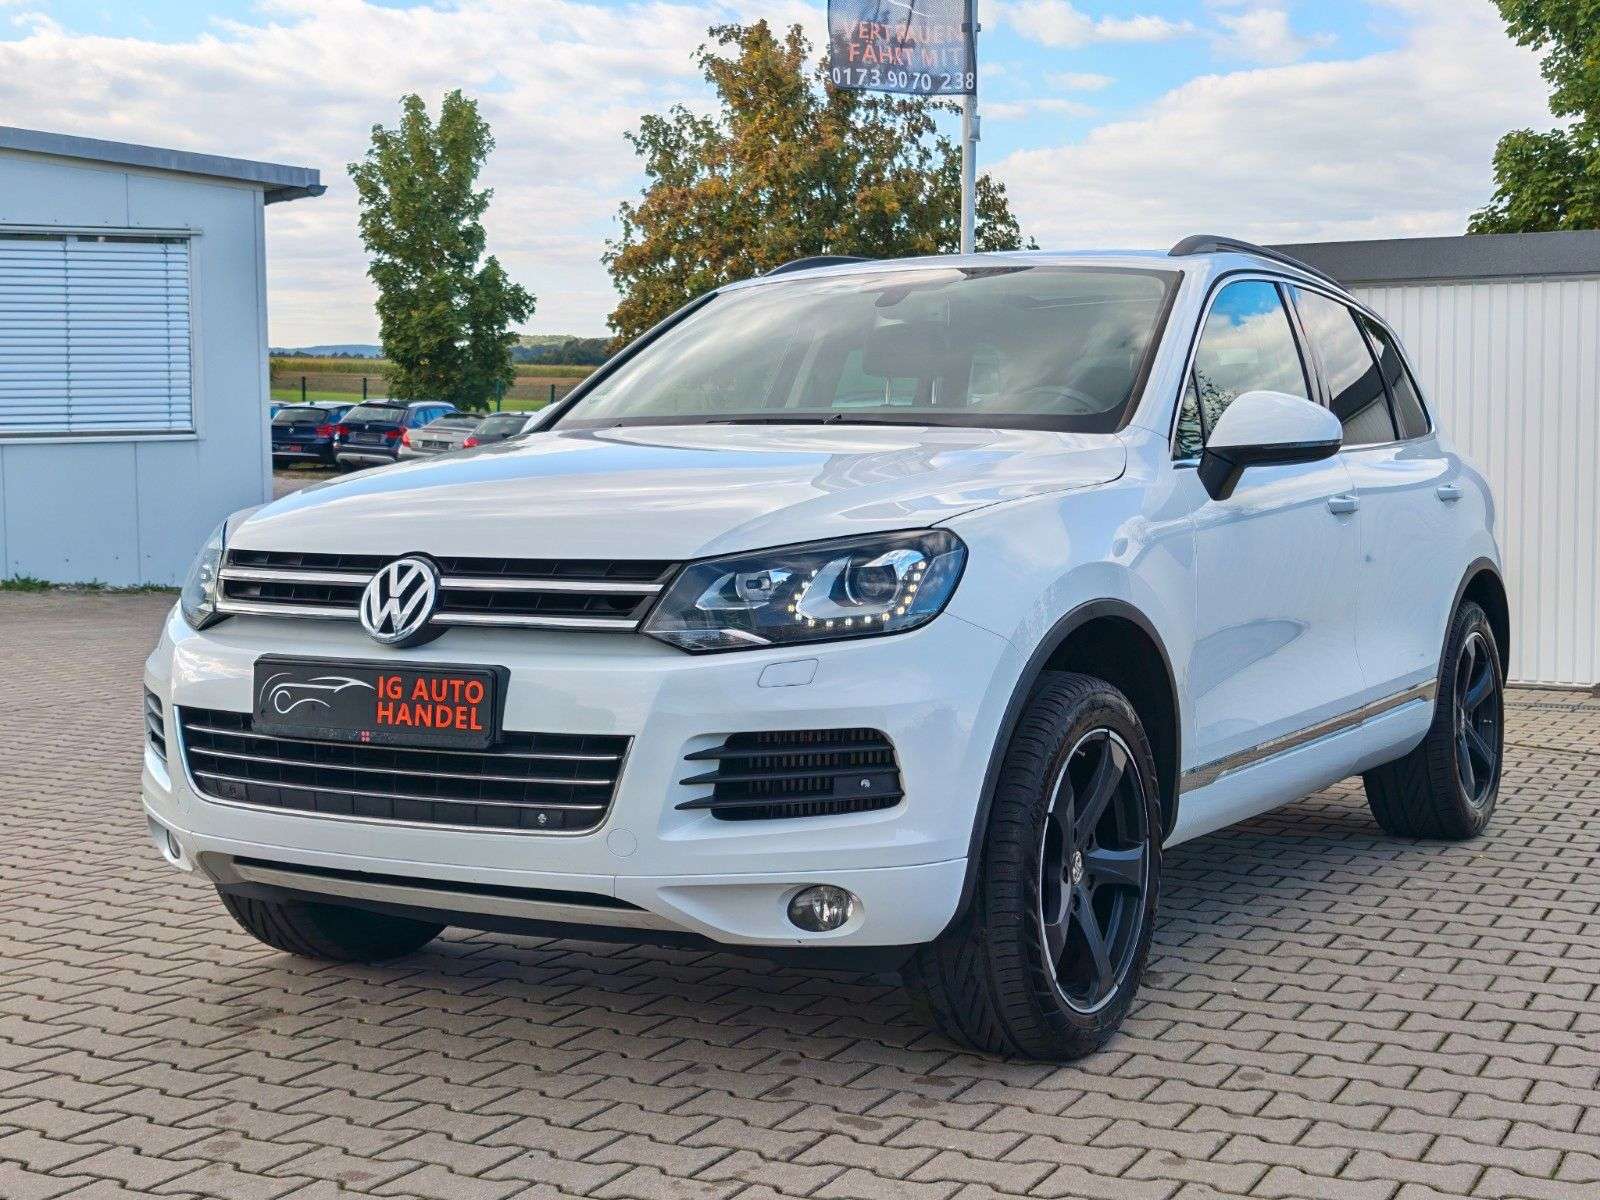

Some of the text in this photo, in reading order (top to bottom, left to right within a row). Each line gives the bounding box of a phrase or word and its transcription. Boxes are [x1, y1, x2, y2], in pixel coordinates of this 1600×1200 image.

[832, 67, 881, 87] 0173
[940, 72, 974, 91] 238
[360, 559, 435, 640] VW
[378, 675, 485, 704] IG AUTO
[377, 702, 483, 730] HANDEL
